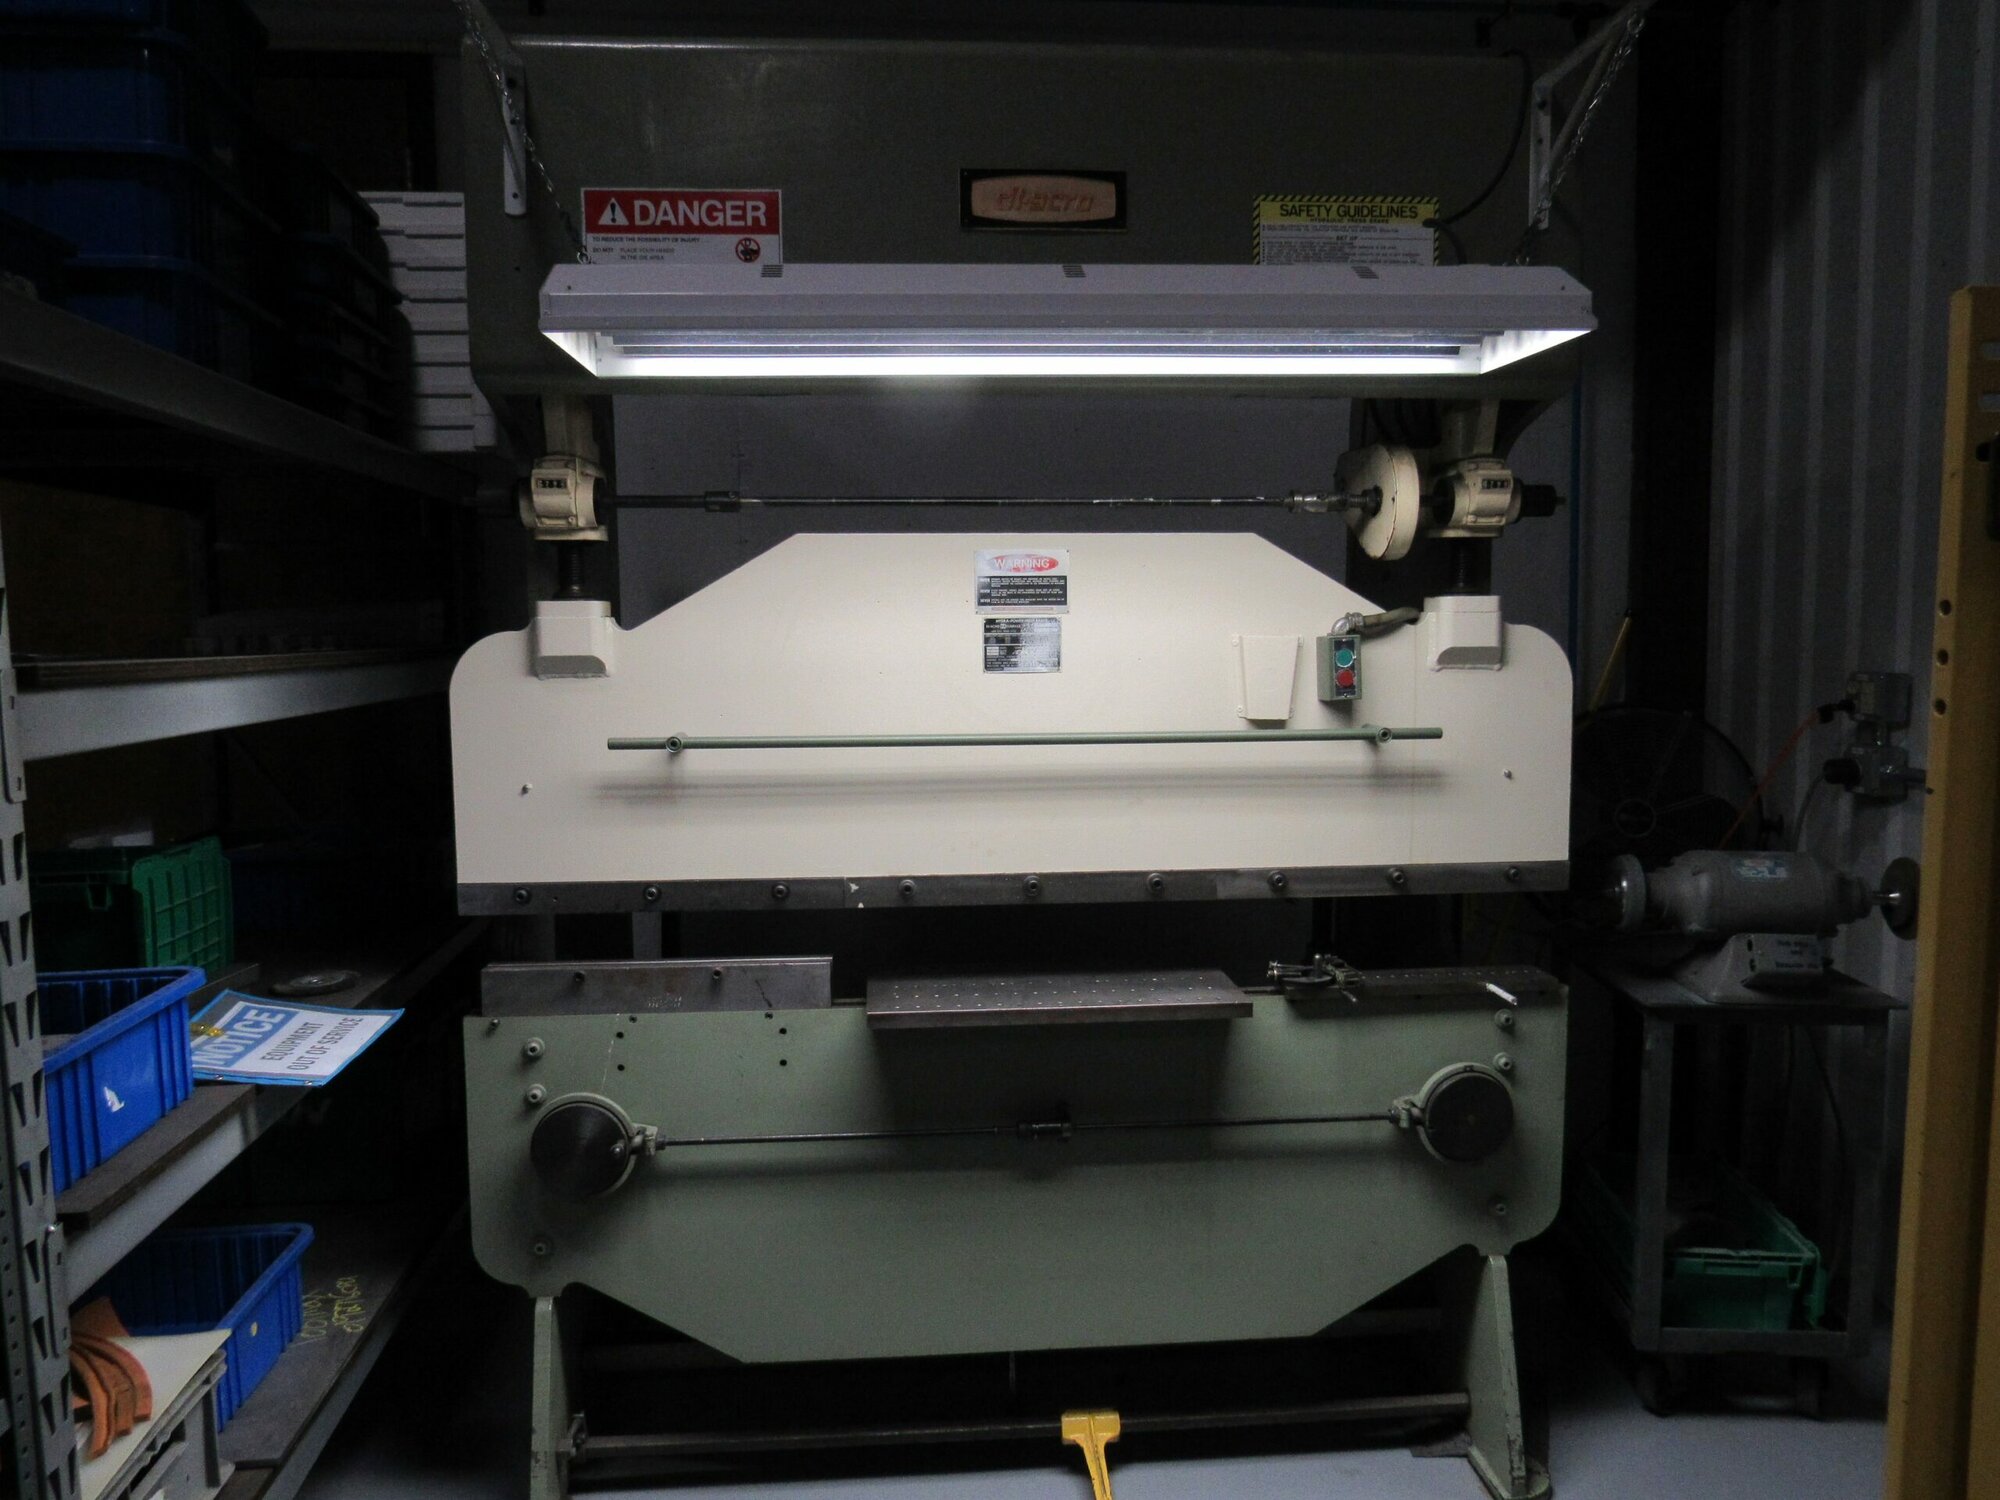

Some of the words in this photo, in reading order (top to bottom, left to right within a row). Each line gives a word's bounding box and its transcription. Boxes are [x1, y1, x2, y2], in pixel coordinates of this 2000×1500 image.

[633, 198, 767, 227] DANGER
[1280, 203, 1333, 218] SAFETY
[1336, 204, 1418, 219] GUIDELINES
[192, 1009, 286, 1065] NOTICE
[259, 1022, 325, 1061] EQUIPMENT
[287, 1050, 318, 1070] OUT
[311, 1040, 329, 1056] OF
[324, 1017, 364, 1046] SERVICE
